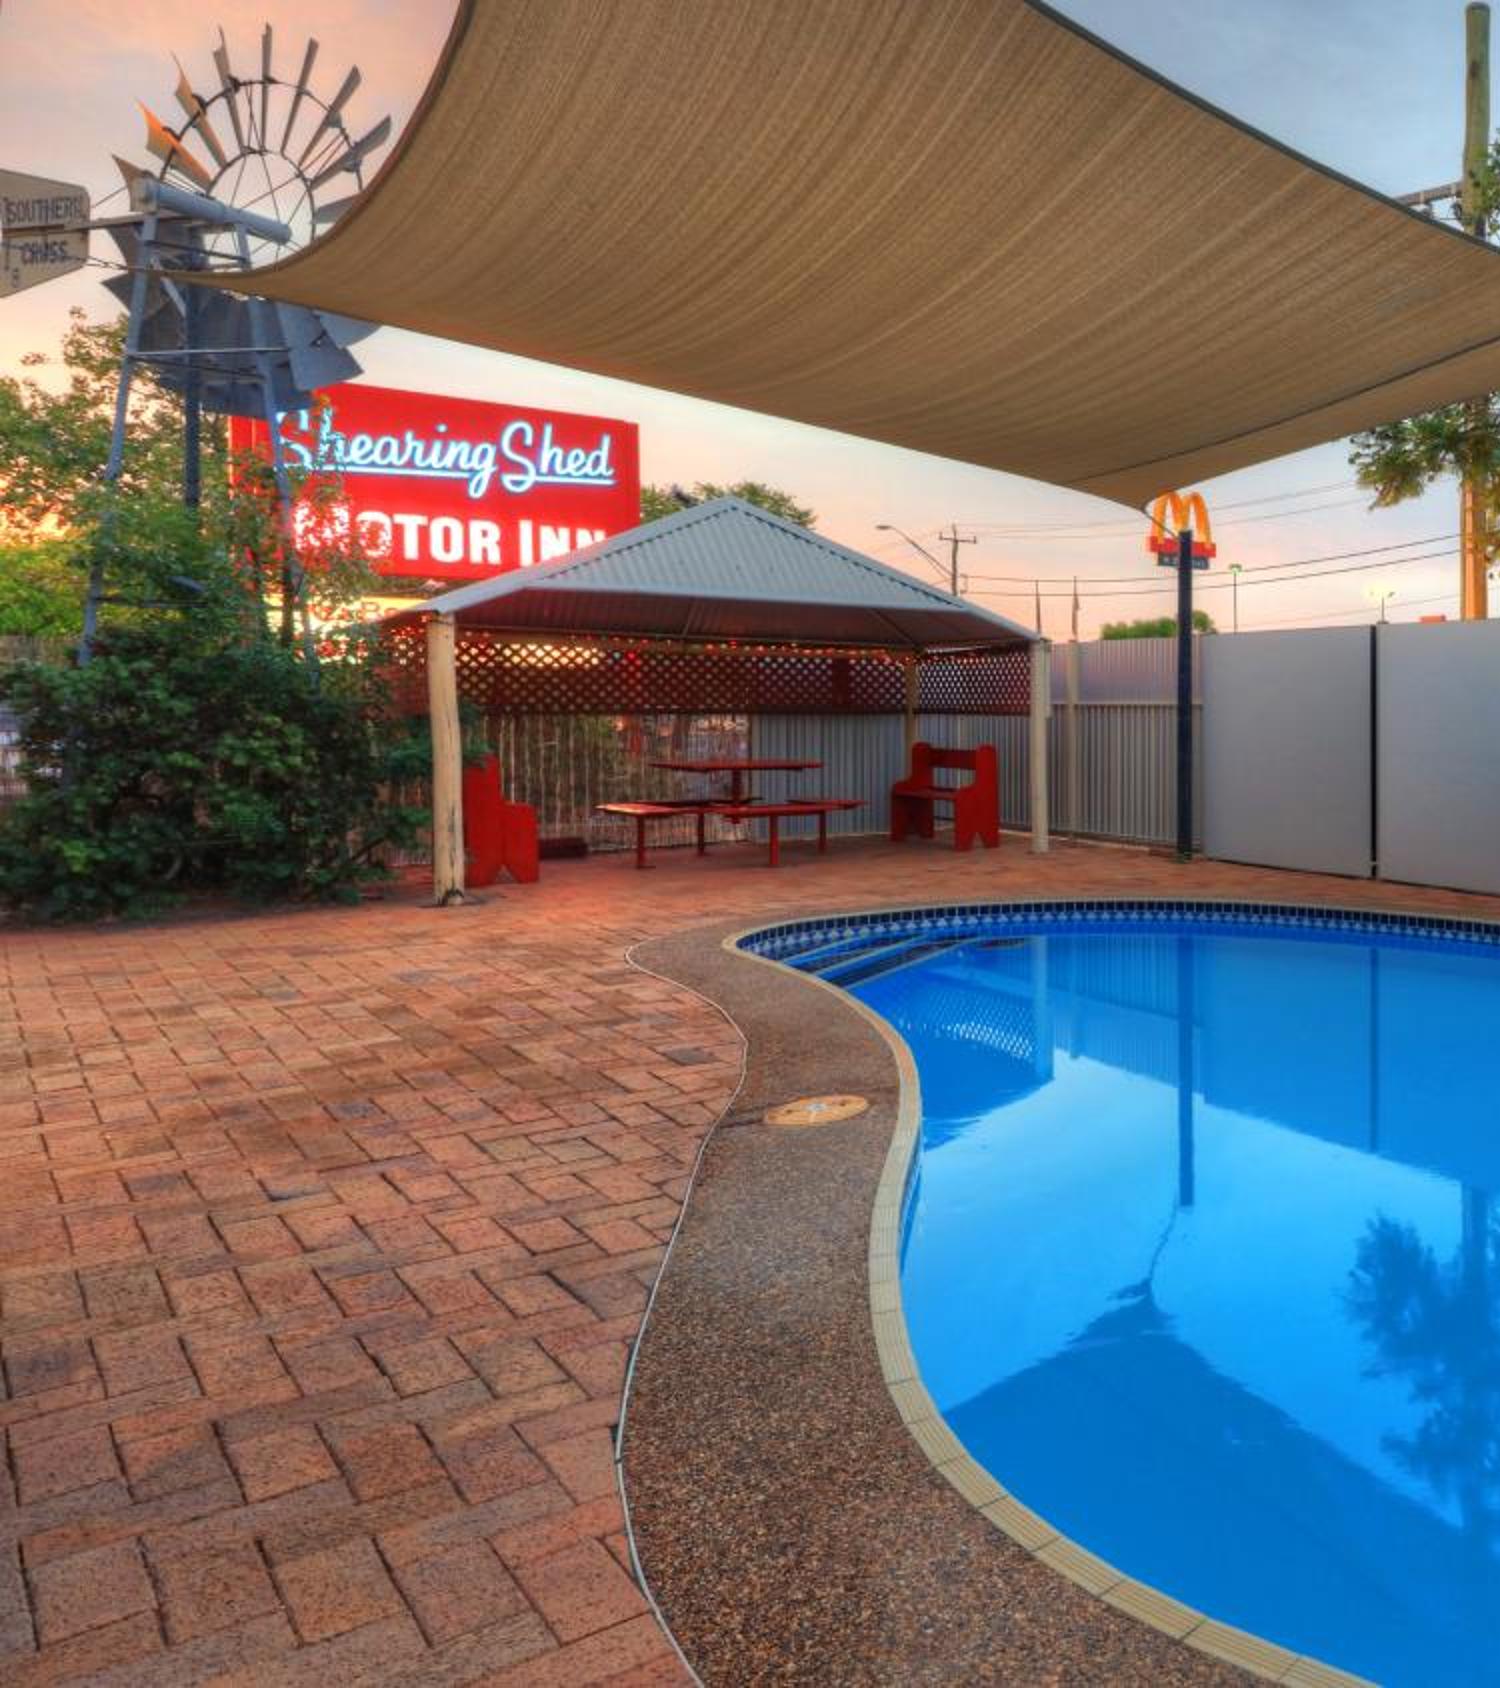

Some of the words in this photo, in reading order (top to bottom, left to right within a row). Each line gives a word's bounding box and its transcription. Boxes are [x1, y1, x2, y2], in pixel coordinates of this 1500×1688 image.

[7, 196, 82, 225] SOUTHERN
[274, 405, 498, 499] Shearing
[500, 420, 616, 494] Shed
[293, 499, 502, 565] MOTOR
